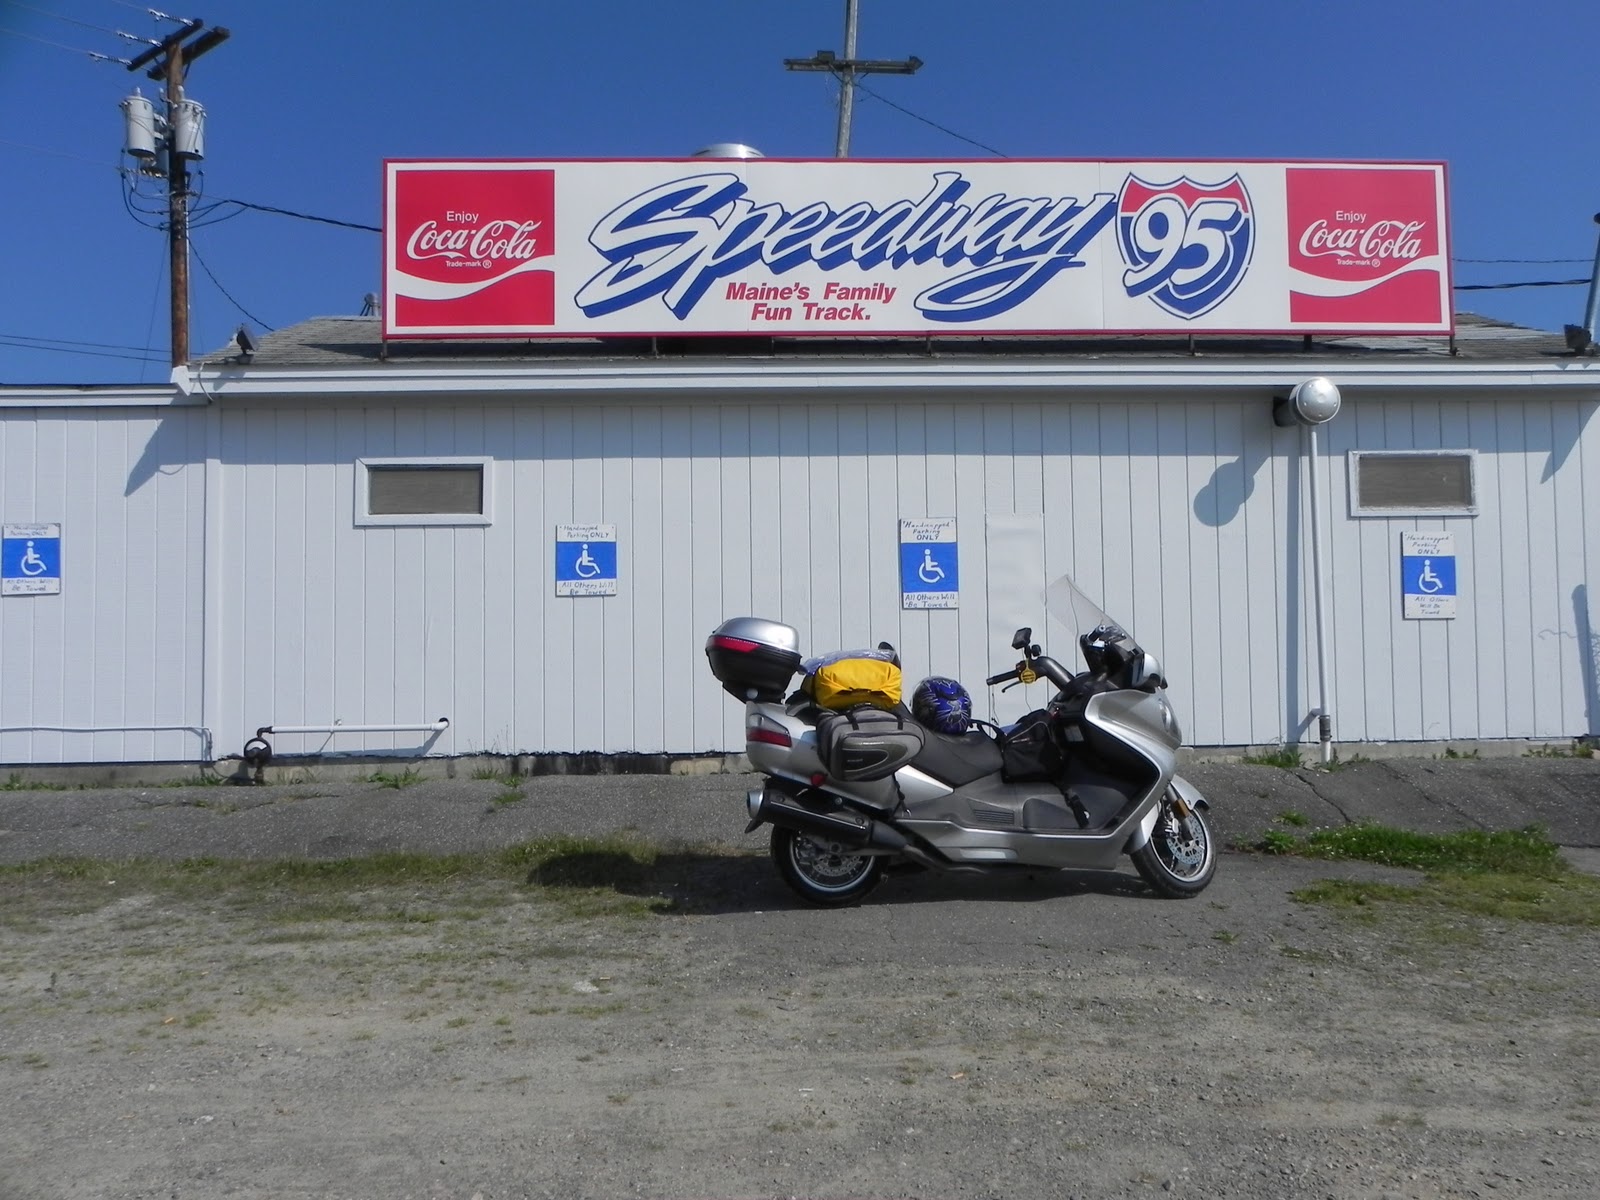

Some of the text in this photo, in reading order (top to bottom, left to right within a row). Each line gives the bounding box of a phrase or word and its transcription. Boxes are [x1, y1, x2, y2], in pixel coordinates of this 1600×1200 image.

[446, 210, 479, 224] Enjoy
[1335, 210, 1367, 223] Enjoy
[406, 219, 542, 260] Coca-Cola
[1299, 219, 1426, 259] Coca-Cola
[574, 171, 1243, 322] Speedway 95
[446, 260, 482, 268] Trade-mark
[1336, 258, 1371, 266] Trade-mark
[725, 282, 897, 304] Maine's Family
[751, 303, 871, 321] Fun Track.
[590, 531, 609, 539] ONLY
[574, 581, 598, 589] Others
[569, 588, 580, 596] Be
[905, 593, 916, 601] All
[916, 593, 940, 601] Others
